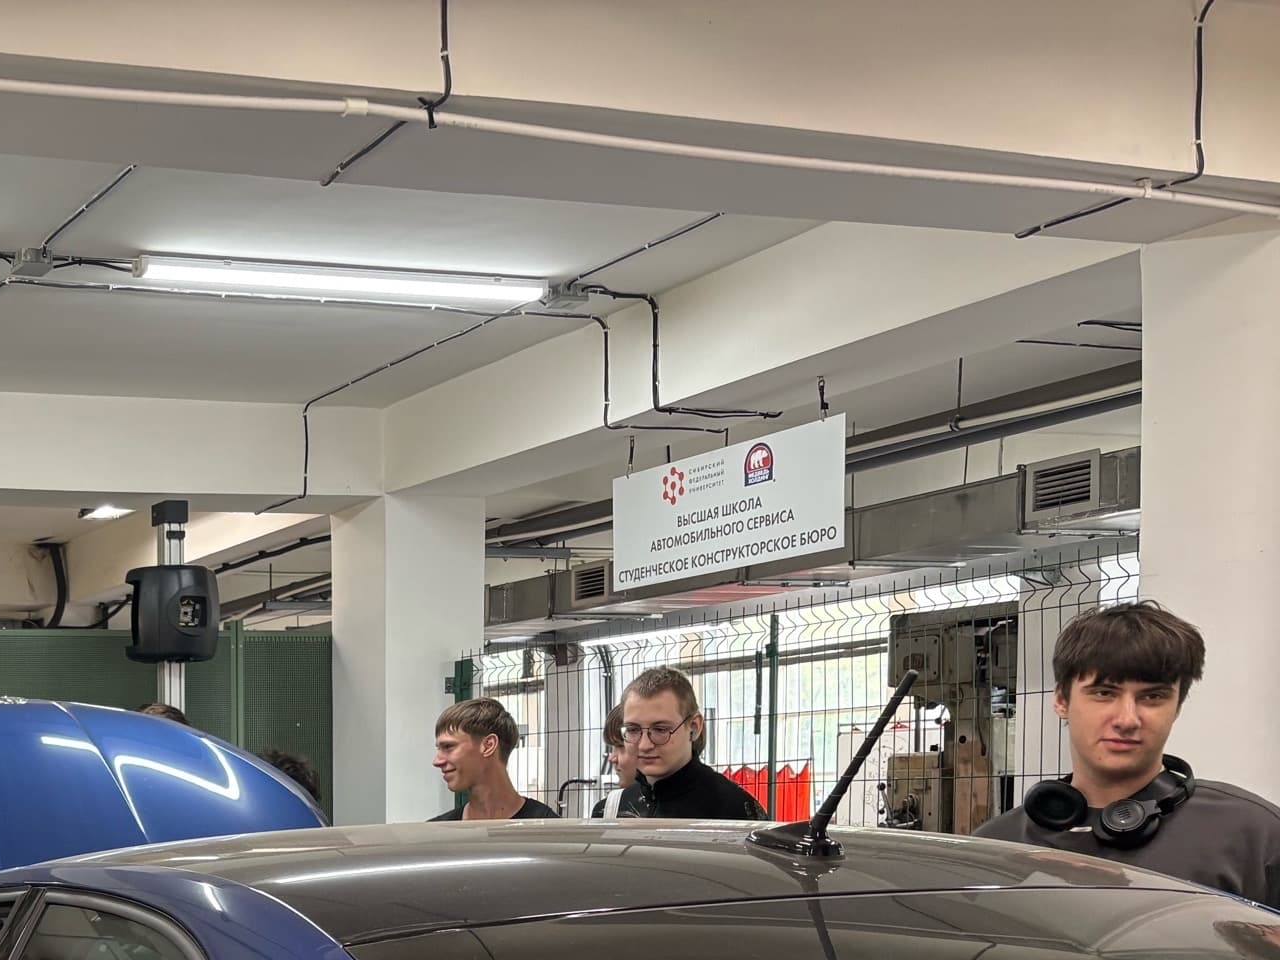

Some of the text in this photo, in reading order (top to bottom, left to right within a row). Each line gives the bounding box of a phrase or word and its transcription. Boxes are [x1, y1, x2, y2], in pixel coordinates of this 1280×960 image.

[650, 508, 795, 553] АВТОМОБИЛЬНОГО СЕРВИСА
[677, 496, 762, 528] ВЫСШАЯ ШКОЛА
[618, 525, 837, 583] СТУДЕНЧЕСКОЕ КОНСТРУКТОРСКОЕ БЮРО
